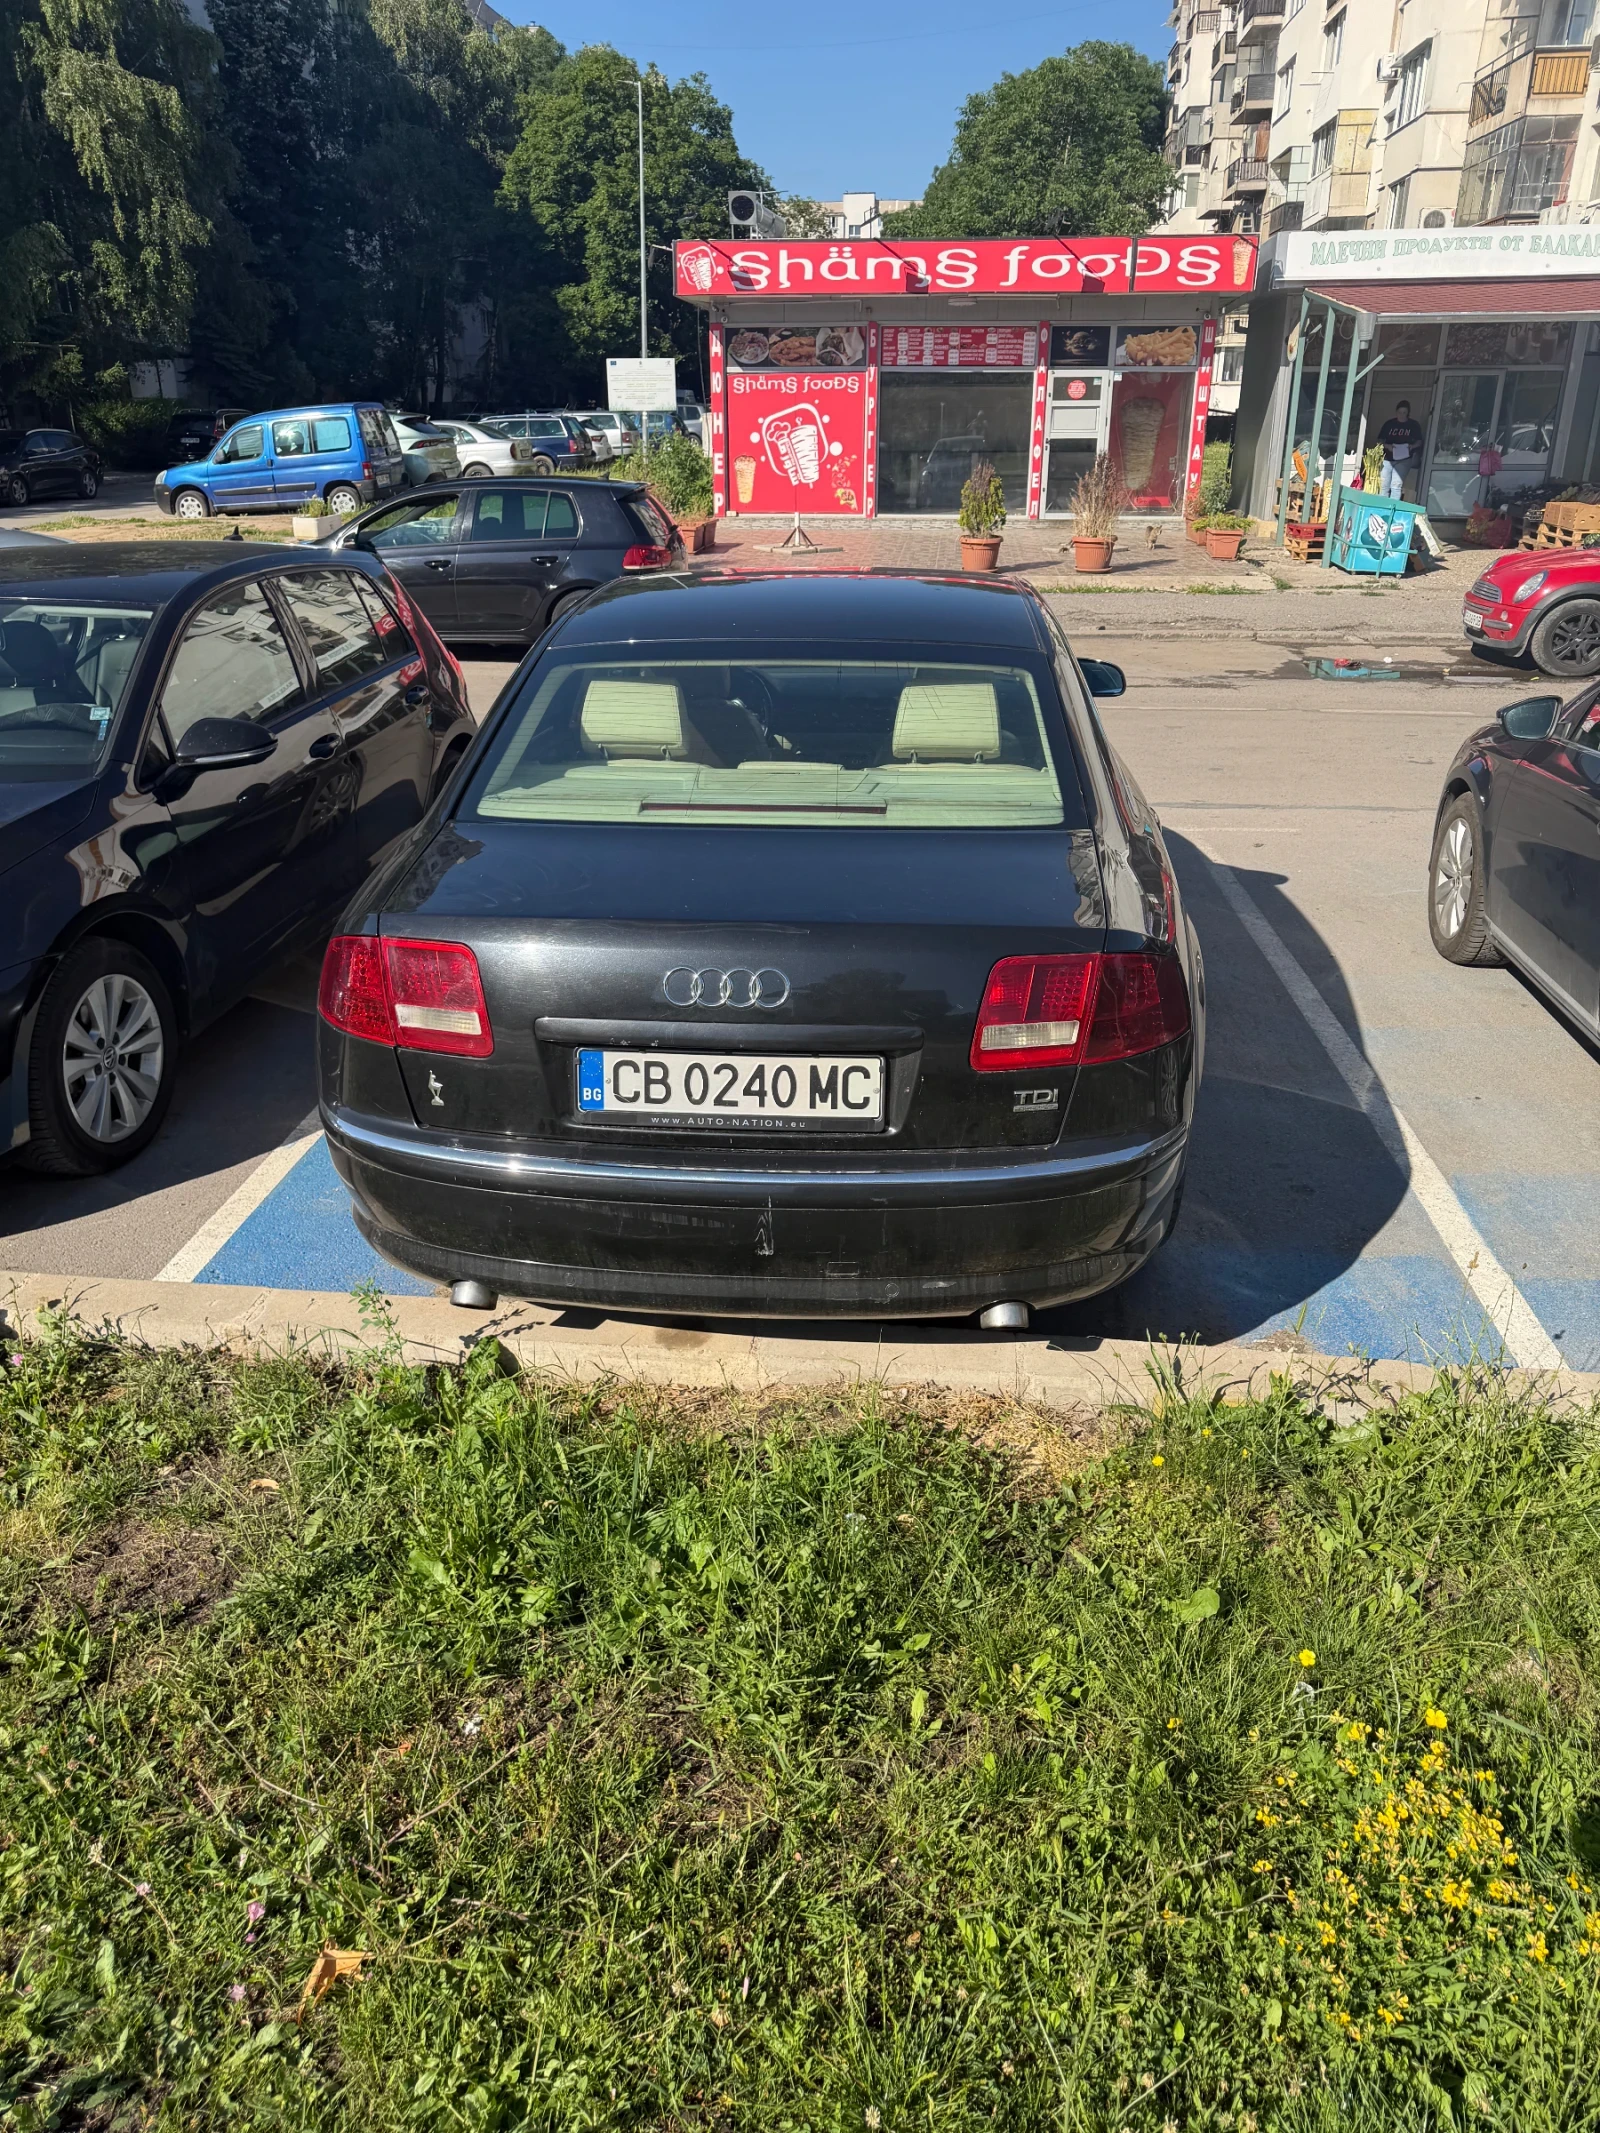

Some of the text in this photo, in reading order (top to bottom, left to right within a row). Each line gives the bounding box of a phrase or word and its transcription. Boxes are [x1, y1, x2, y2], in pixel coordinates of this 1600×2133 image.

[1310, 240, 1387, 265] МЛЕЧНИ
[1393, 236, 1493, 256] ПРОДУКТИ
[1499, 236, 1523, 251] ОТ
[712, 329, 724, 514] ДЮНЕР
[867, 328, 876, 515] БУРГЕР
[1030, 327, 1048, 516] ФАЛАФЕЛ
[1190, 326, 1213, 489] ШИШТАУ
[1389, 428, 1410, 436] ICON
[583, 1088, 602, 1101] BG
[612, 1059, 871, 1110] CB 0240 MC
[1013, 1088, 1058, 1105] TDI
[651, 1117, 806, 1128] www.AUTO-NATION.eu
